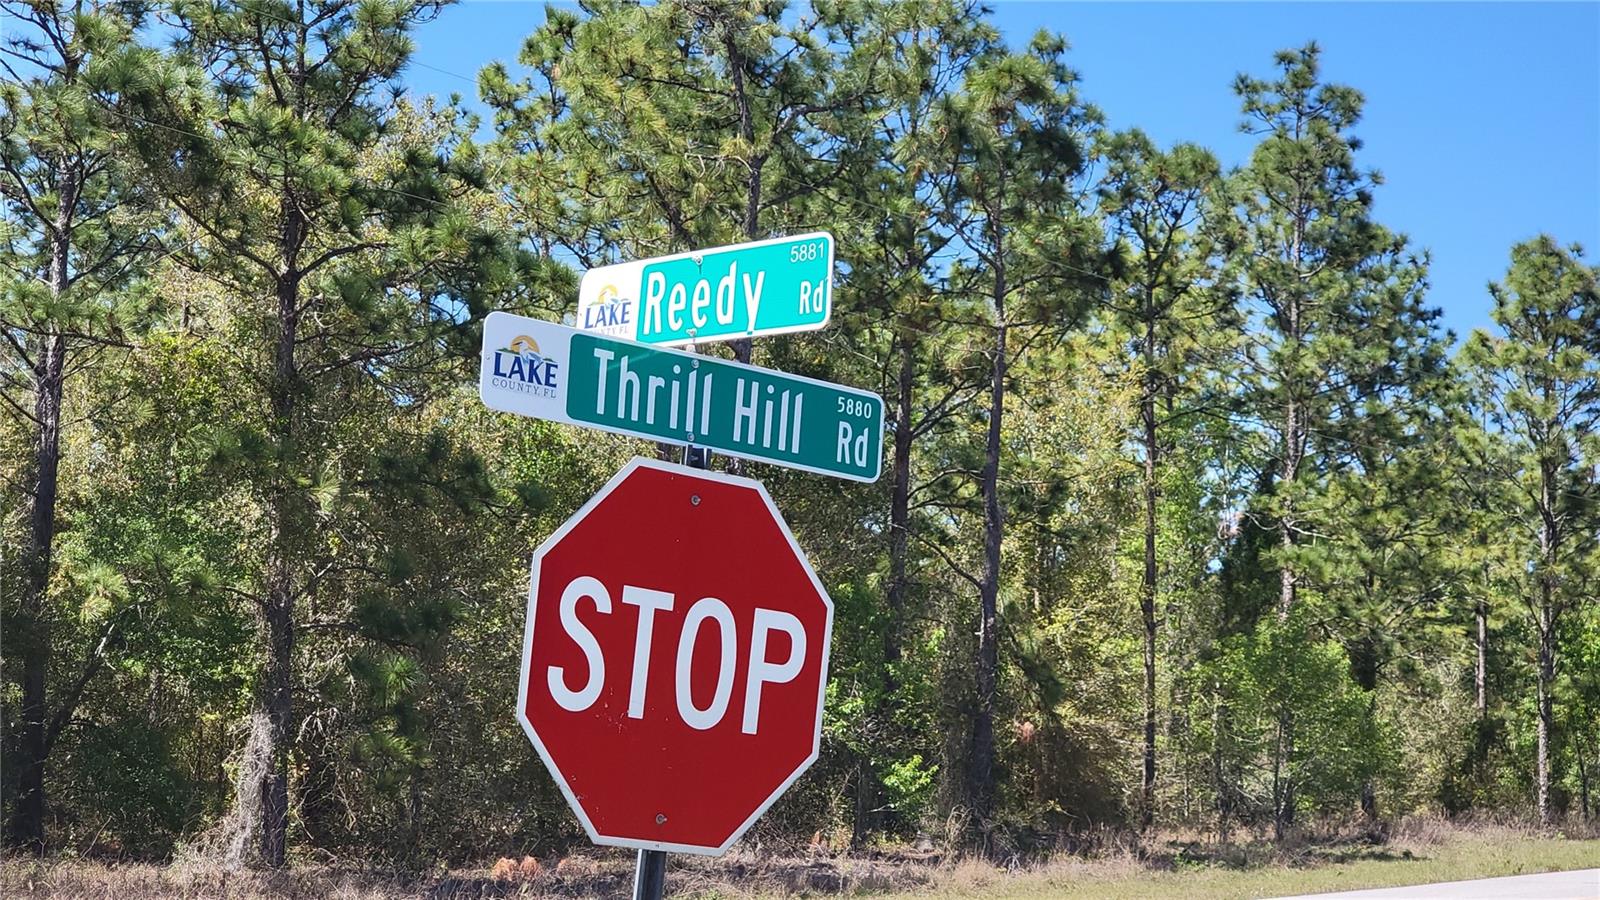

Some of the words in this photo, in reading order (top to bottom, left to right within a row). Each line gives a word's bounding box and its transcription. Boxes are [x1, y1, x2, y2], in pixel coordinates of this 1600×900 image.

[789, 241, 826, 263] 5881
[584, 301, 632, 329] LAKE
[643, 260, 765, 335] Reedy
[798, 278, 828, 315] Rd
[492, 351, 559, 388] LAKE
[543, 388, 557, 399] FL
[593, 347, 713, 436] Thrill
[732, 378, 803, 454] Hill
[837, 396, 872, 420] 5880
[836, 421, 870, 468] Rd
[547, 576, 807, 735] STOP
